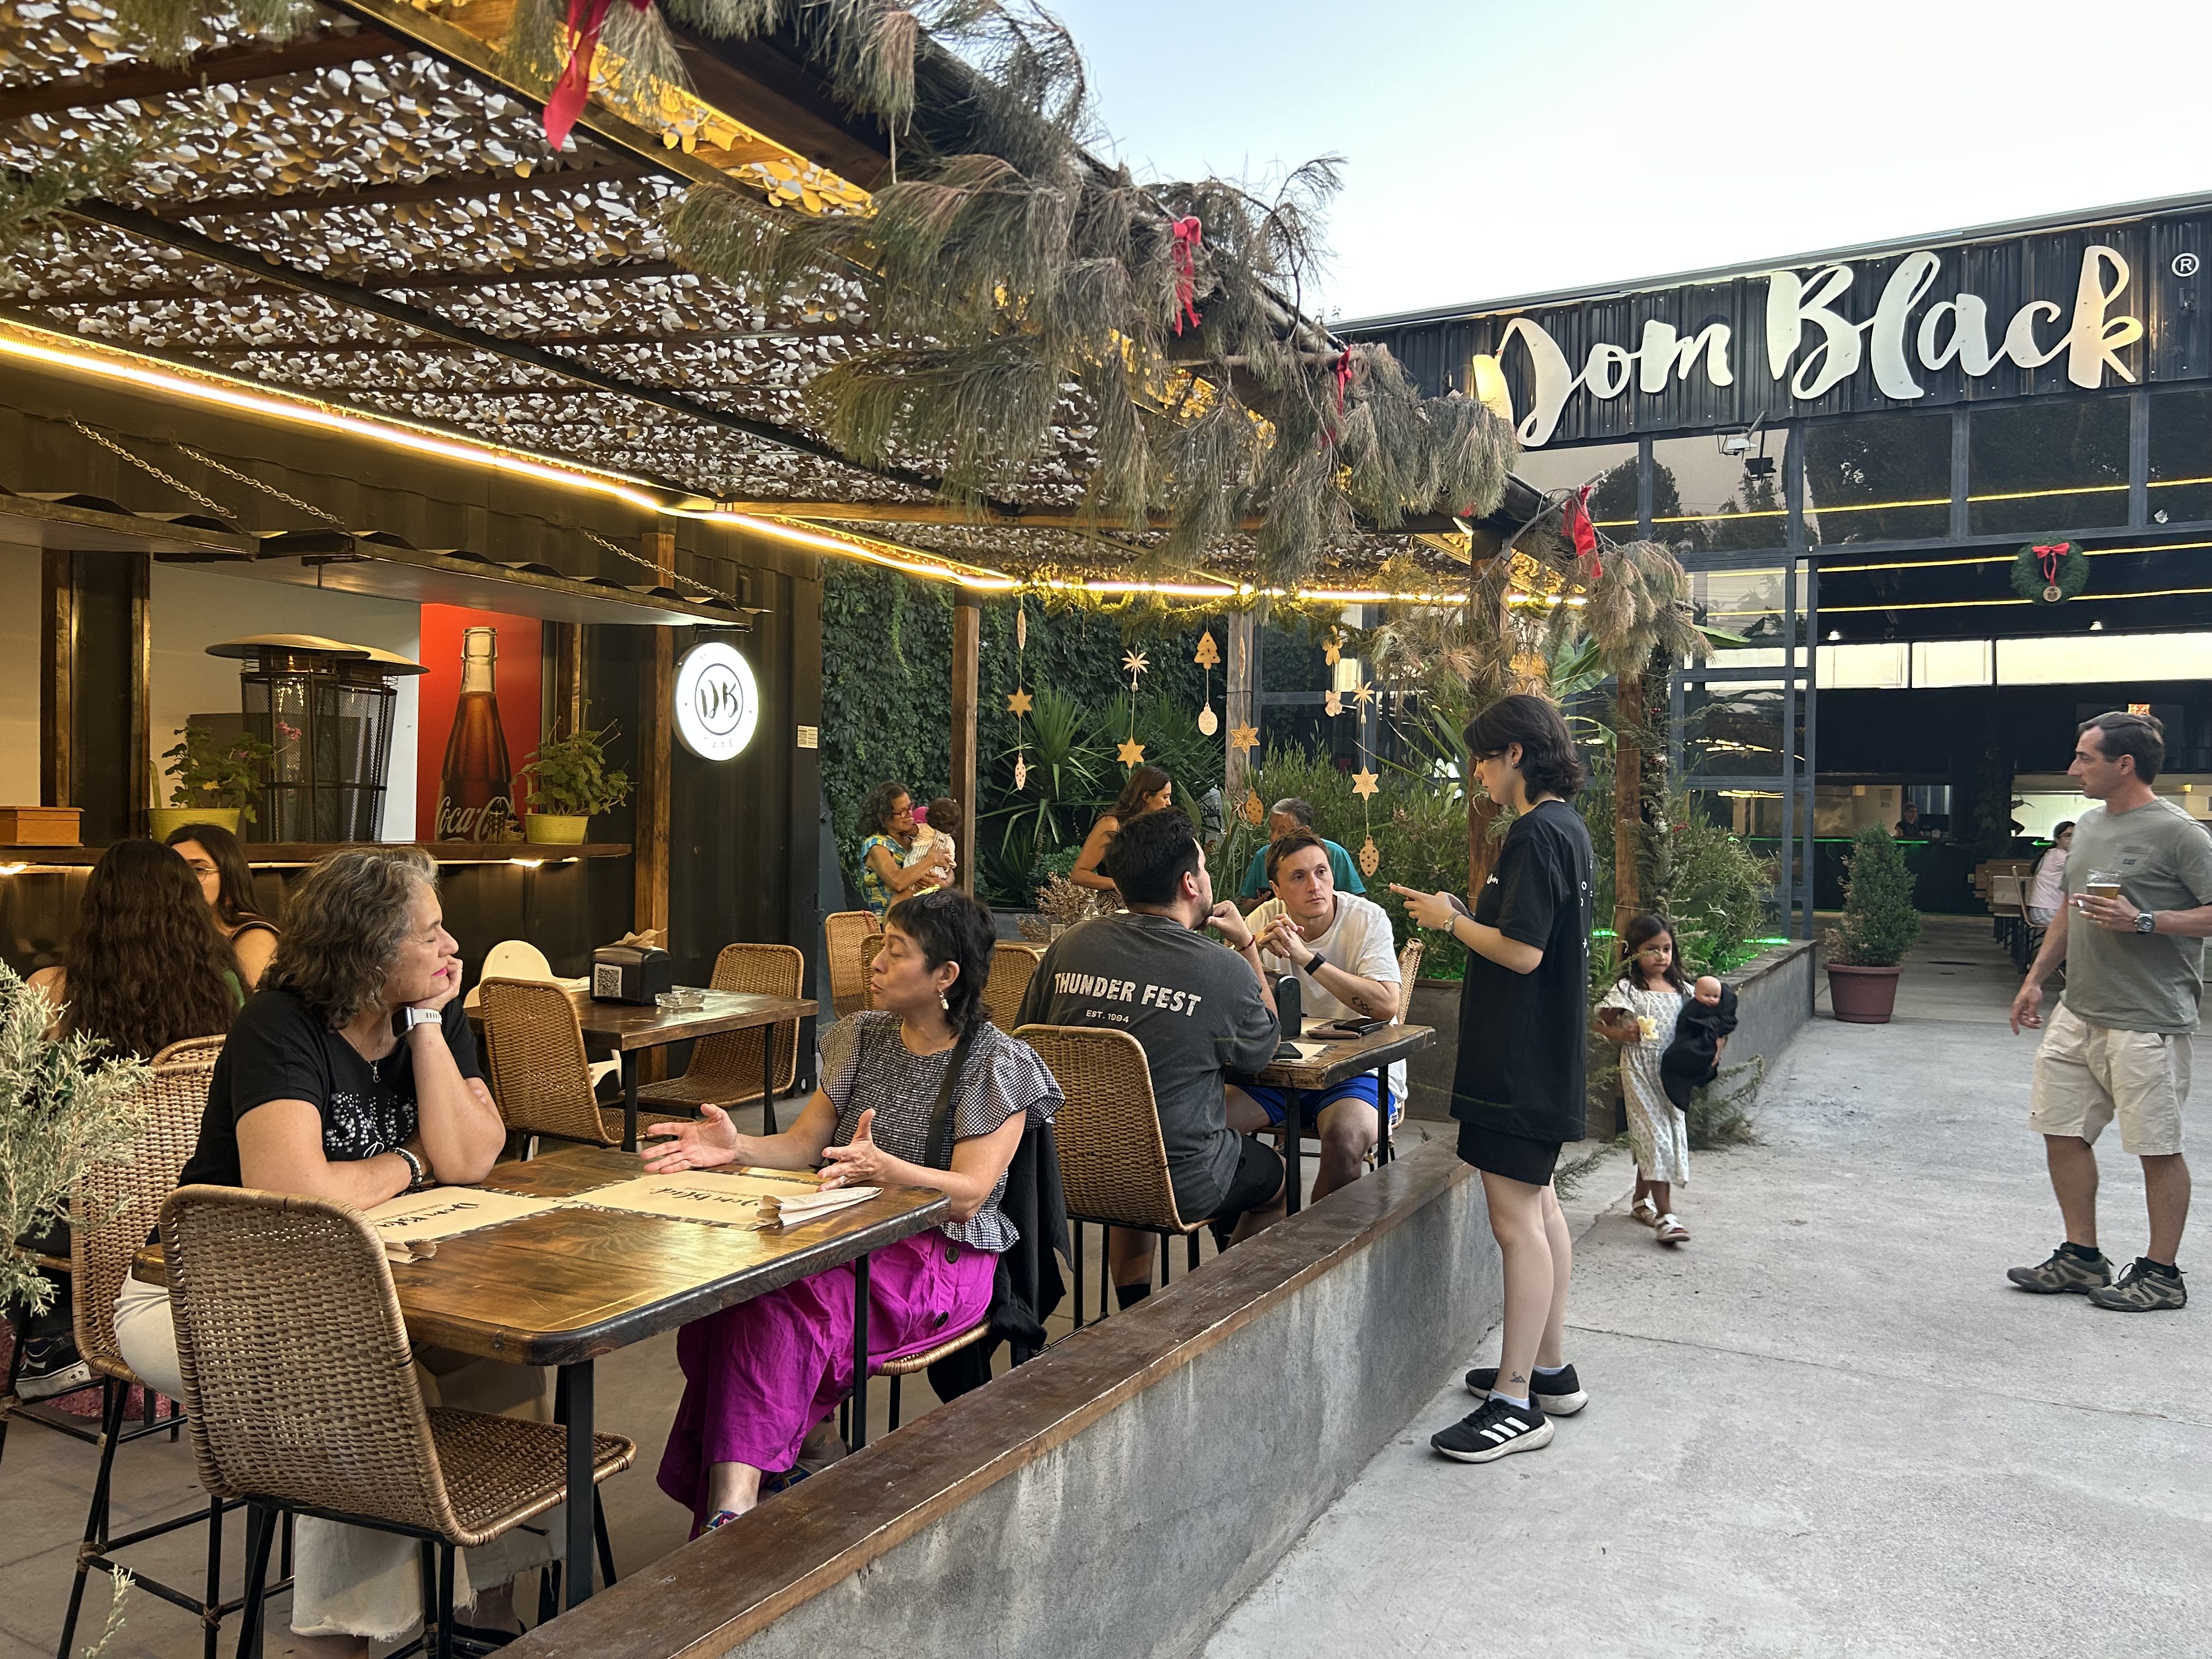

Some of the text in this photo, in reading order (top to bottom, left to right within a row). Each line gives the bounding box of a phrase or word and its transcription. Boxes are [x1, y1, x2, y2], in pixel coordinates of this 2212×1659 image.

[1472, 318, 1734, 447] Dom
[1766, 246, 2144, 400] Black
[1054, 973, 1202, 1017] THUNDER FEST
[1086, 1009, 1130, 1023] EST. 1994
[374, 1216, 430, 1227] Bla
